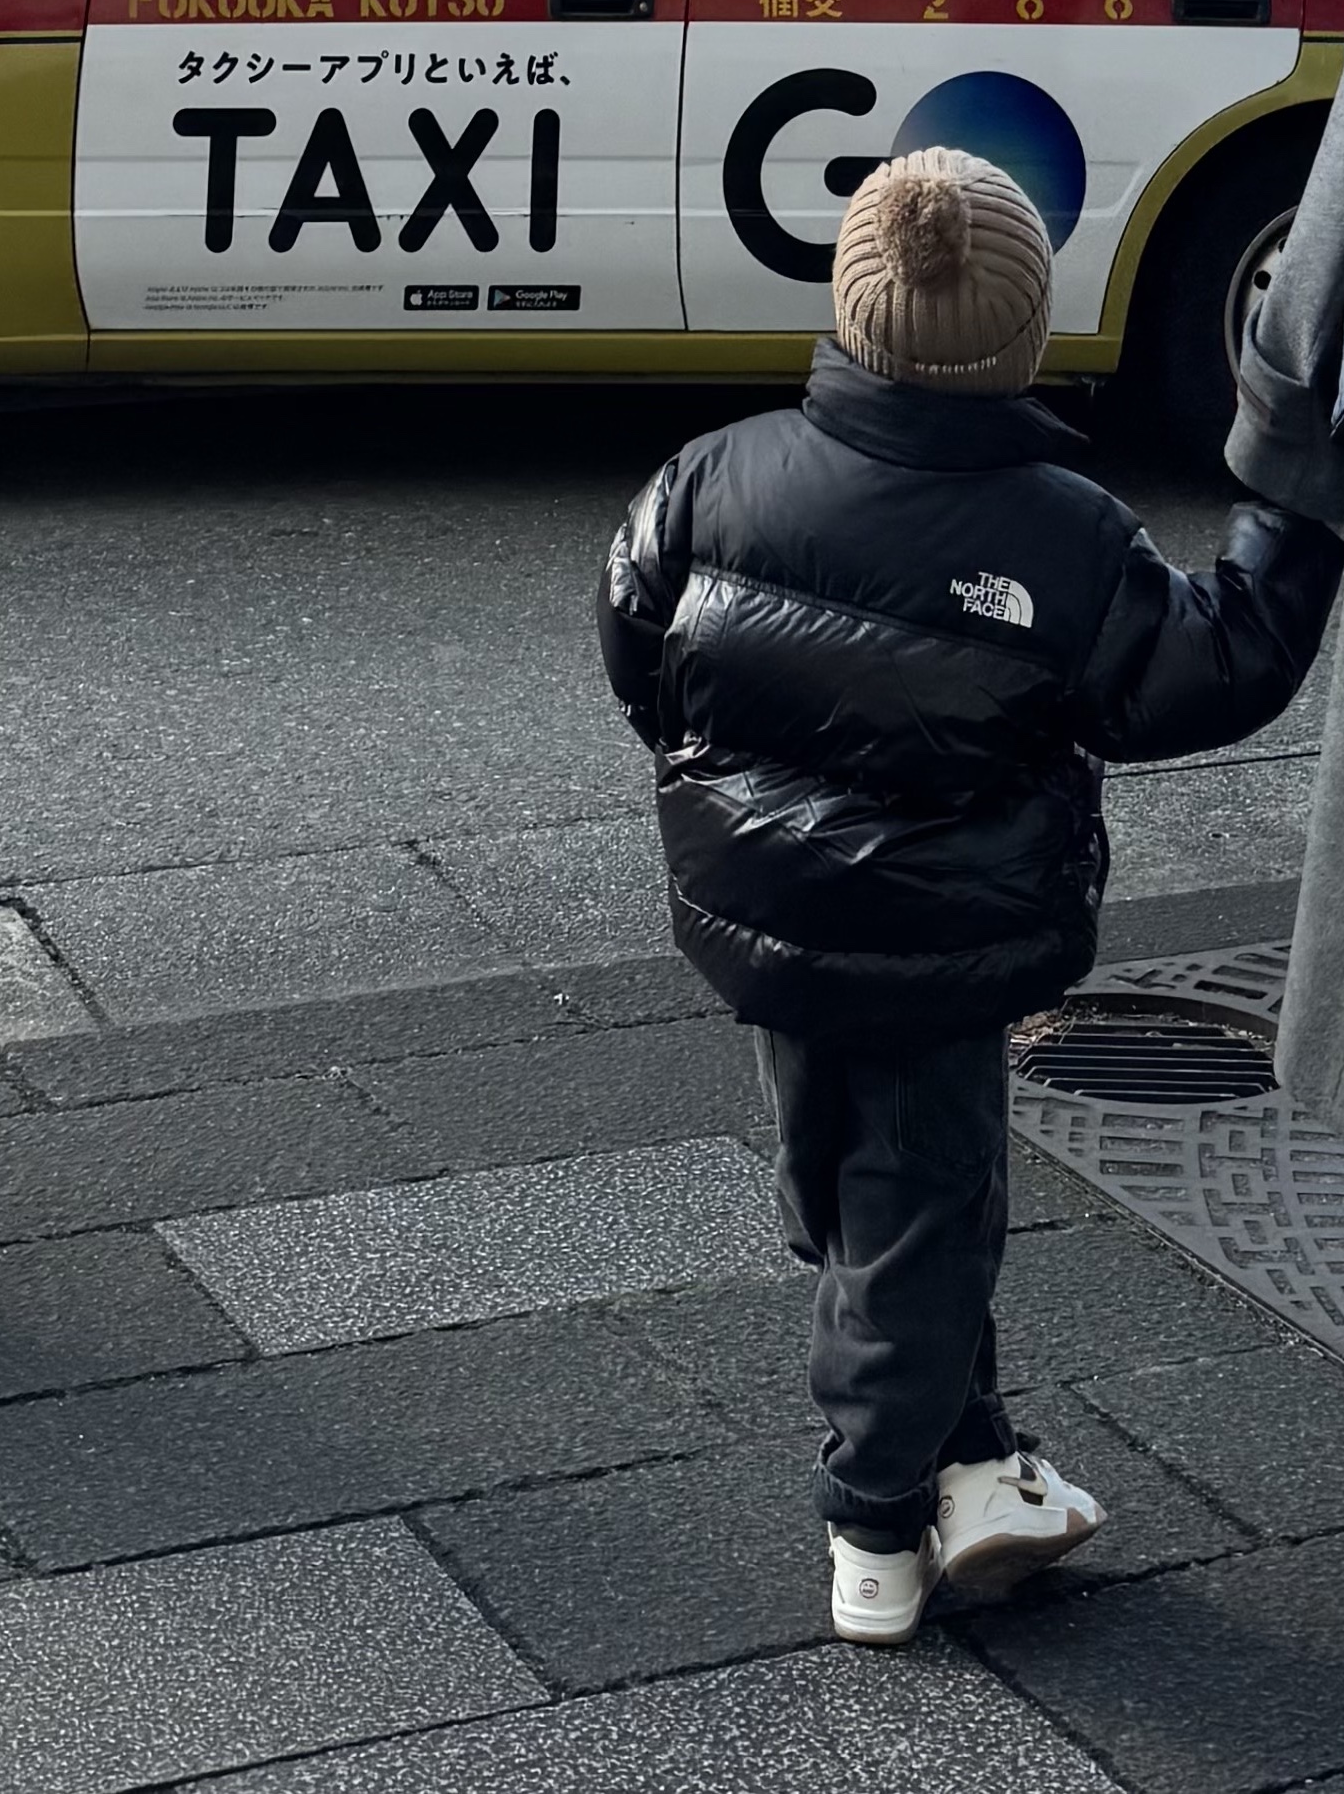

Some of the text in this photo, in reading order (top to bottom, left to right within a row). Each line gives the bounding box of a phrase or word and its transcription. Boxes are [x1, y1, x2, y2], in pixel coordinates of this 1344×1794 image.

[177, 49, 572, 87] タクシーアプリといえば、
[172, 107, 561, 254] TAXI
[426, 289, 473, 299] App Store
[515, 289, 568, 302] Google Play
[950, 579, 1007, 606] NORTH
[978, 571, 1011, 592] THE
[963, 598, 1007, 621] FACE
